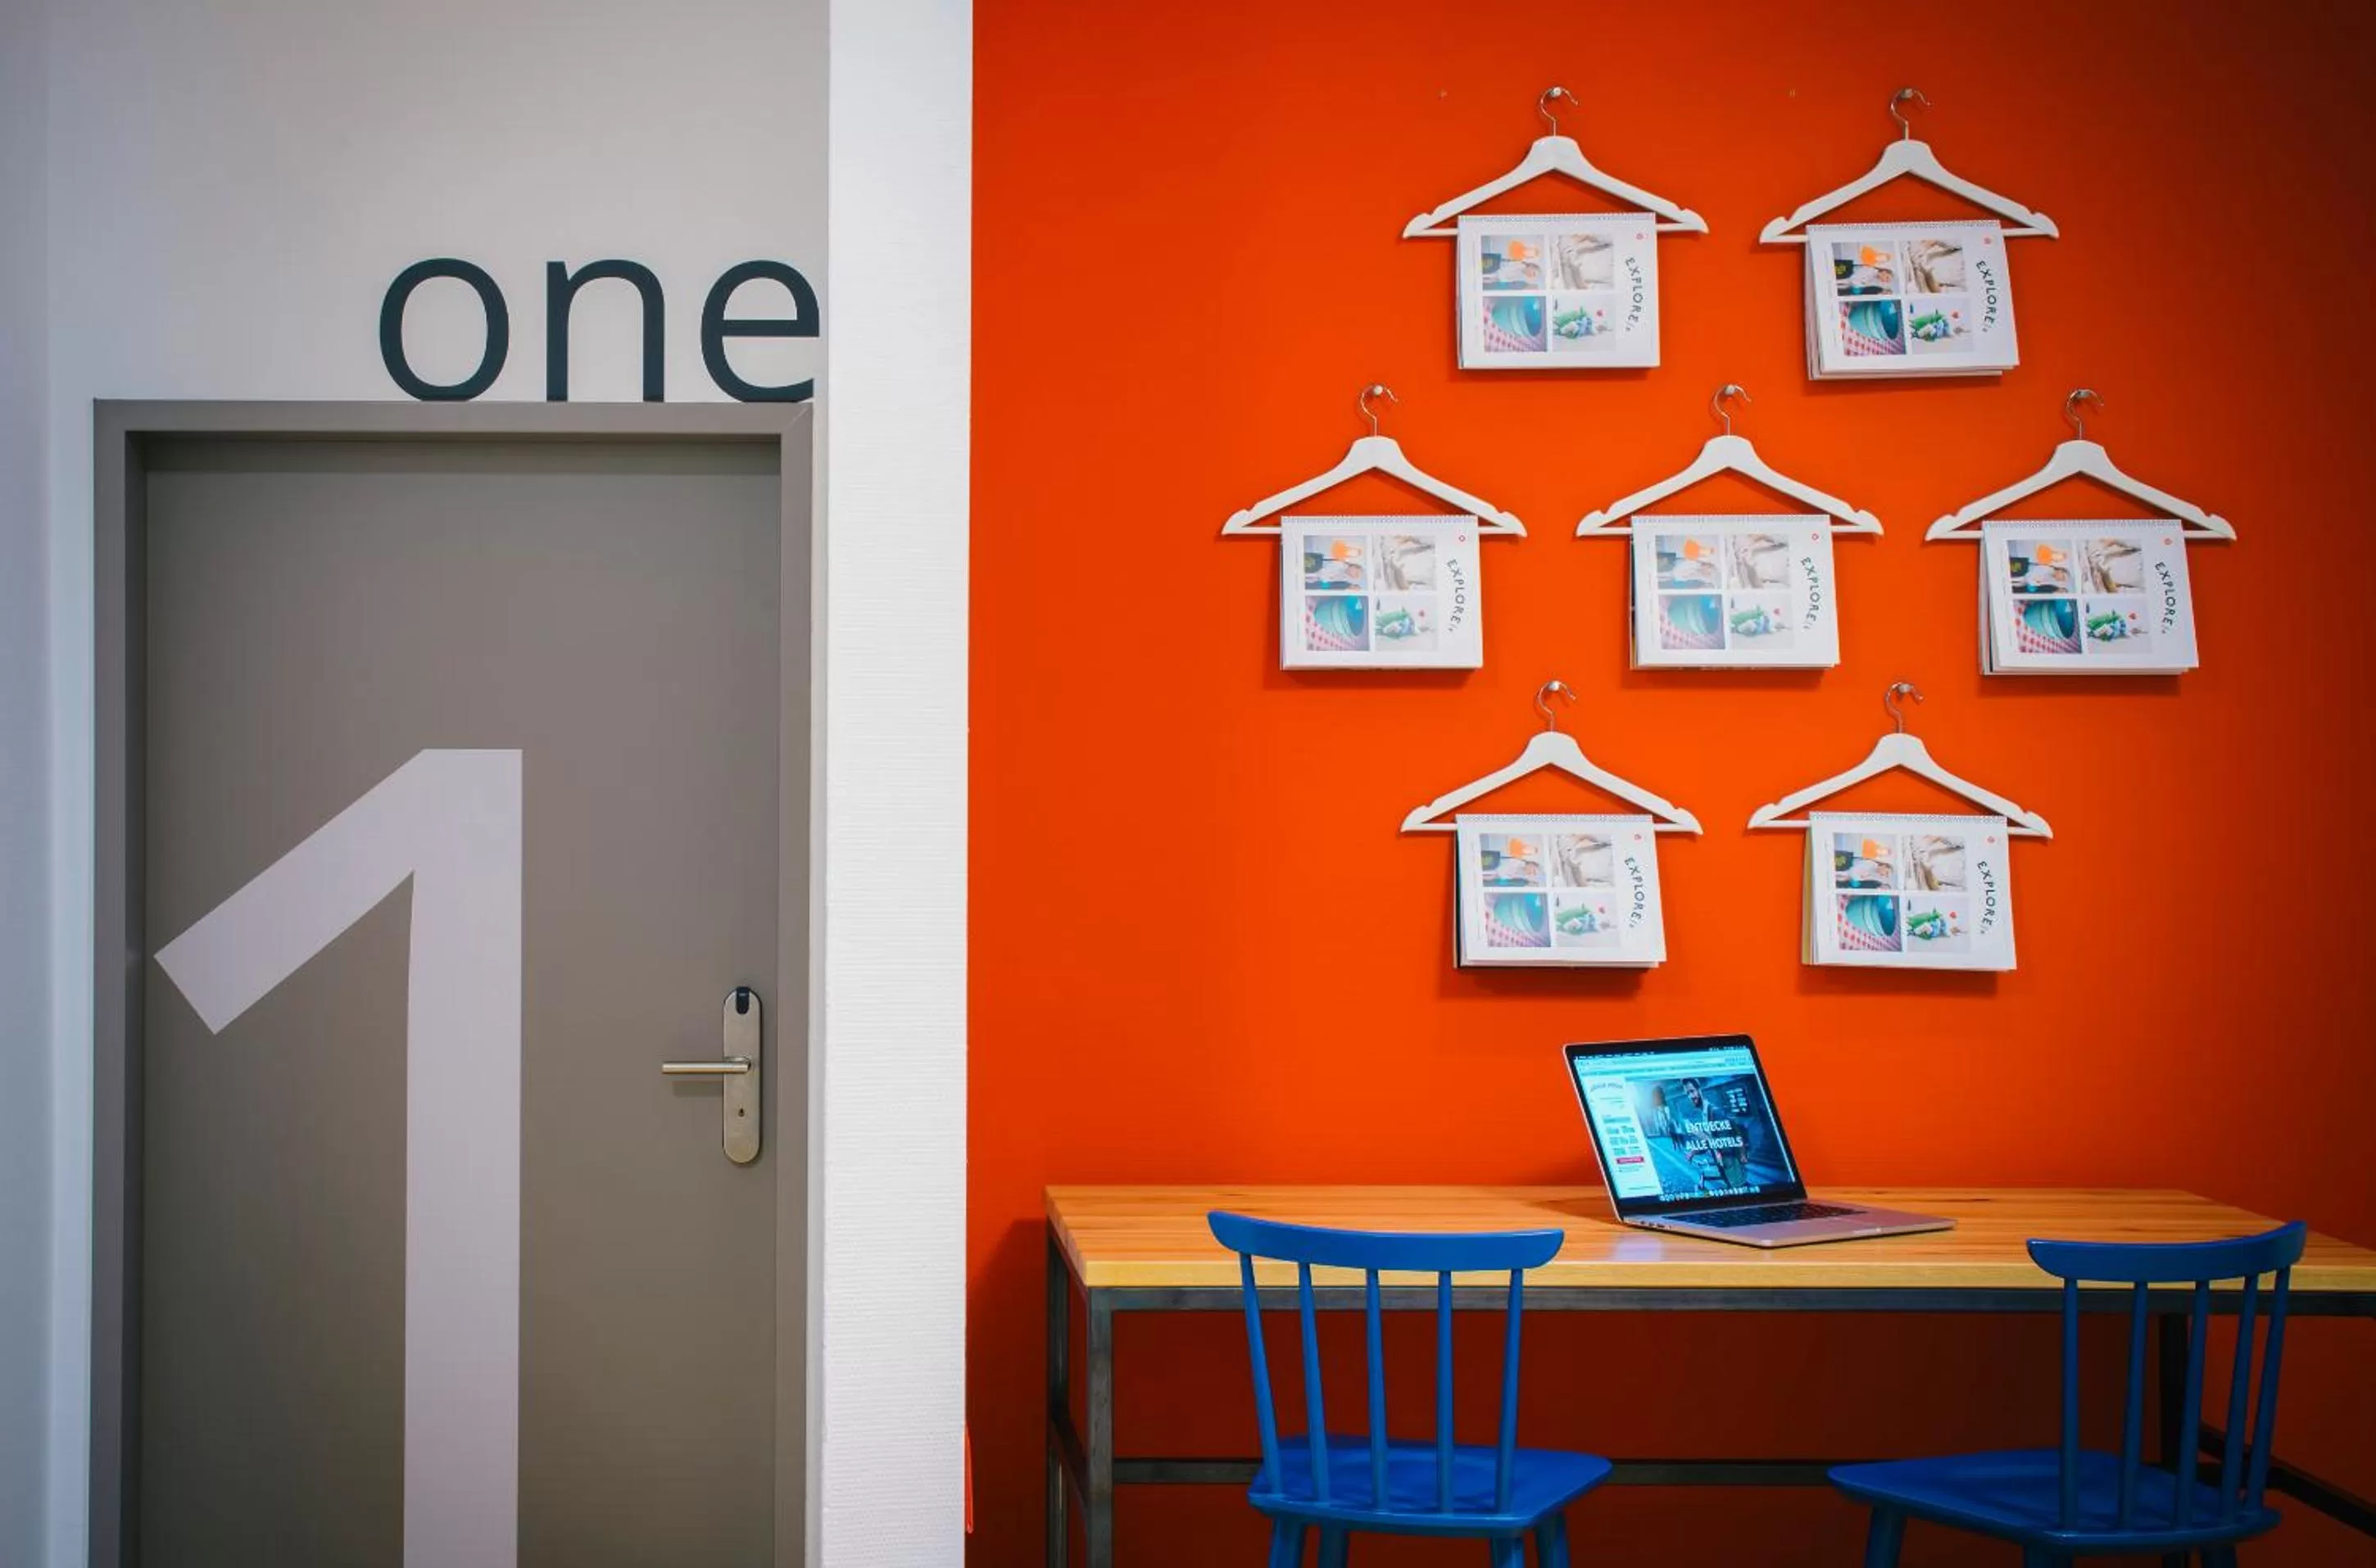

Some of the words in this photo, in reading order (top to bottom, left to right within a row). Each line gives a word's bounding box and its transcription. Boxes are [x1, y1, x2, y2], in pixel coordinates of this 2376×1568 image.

[379, 257, 820, 402] one
[153, 749, 523, 1568] 1
[1685, 1120, 1732, 1133] ENTDECKE
[1685, 1140, 1708, 1151] ALLE
[1708, 1136, 1743, 1149] HOTELS
